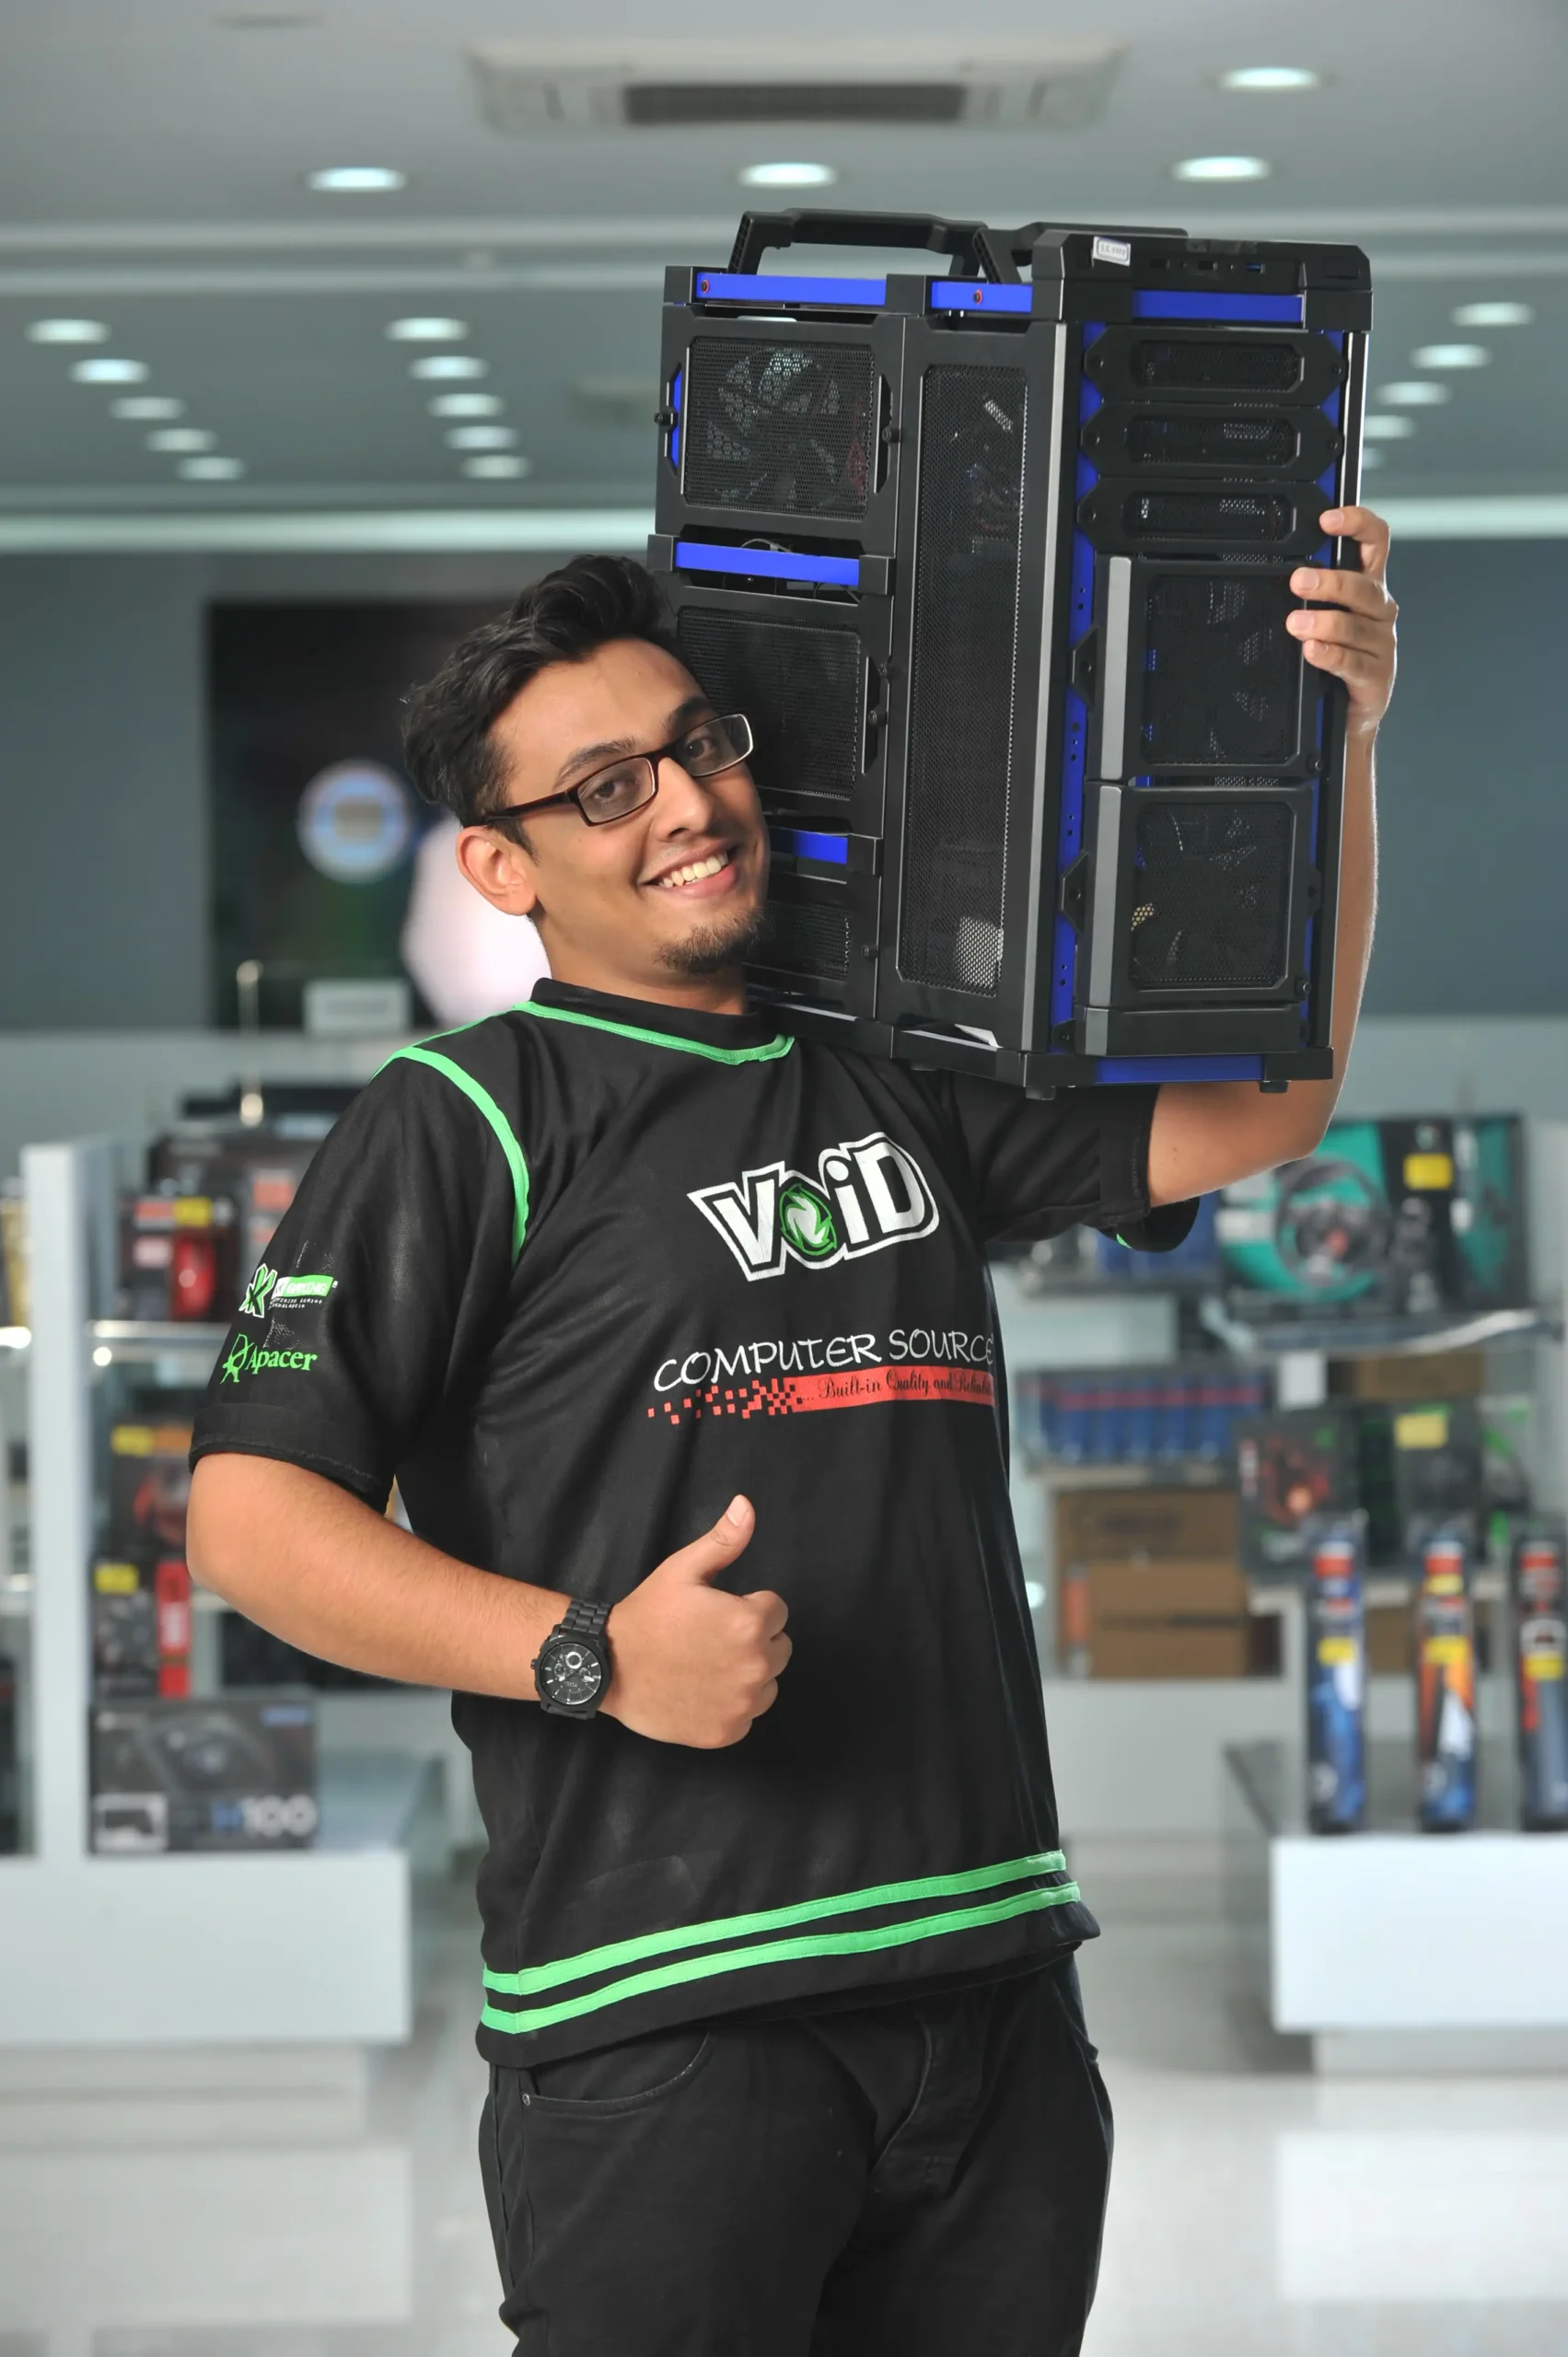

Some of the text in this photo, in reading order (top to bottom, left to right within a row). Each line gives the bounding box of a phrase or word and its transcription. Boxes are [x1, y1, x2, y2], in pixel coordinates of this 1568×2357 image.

[245, 1344, 318, 1375] Apacer
[654, 1329, 994, 1392] COMPUTER SOURCE
[819, 1376, 882, 1399] Built-in
[886, 1369, 929, 1395] Quality
[934, 1371, 954, 1391] and
